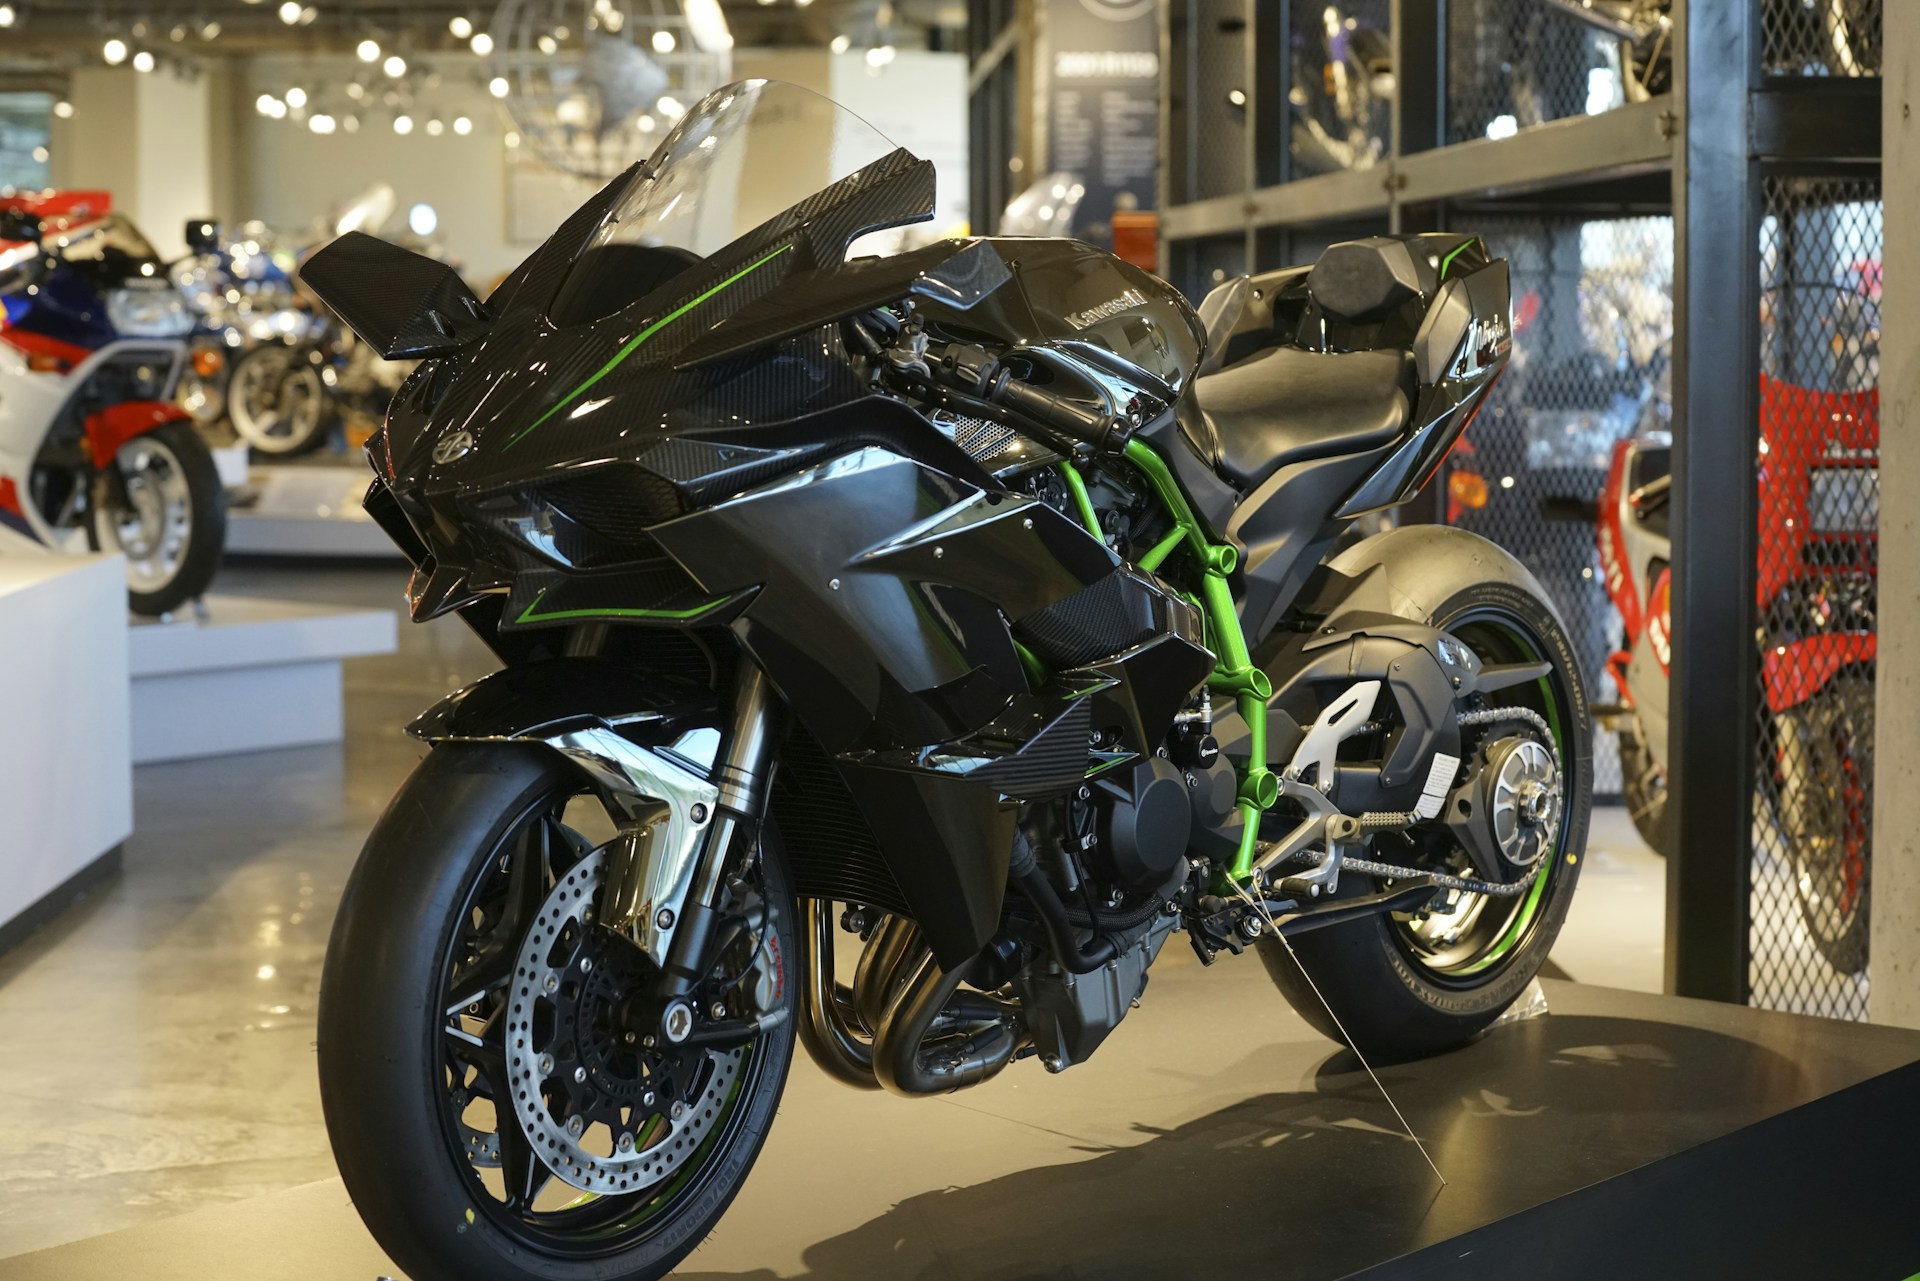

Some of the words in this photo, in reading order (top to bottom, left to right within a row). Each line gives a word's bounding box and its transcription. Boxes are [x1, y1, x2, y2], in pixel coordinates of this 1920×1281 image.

[1064, 288, 1148, 331] Kawasaki
[1476, 314, 1506, 353] Ninja
[770, 935, 785, 1001] brembo
